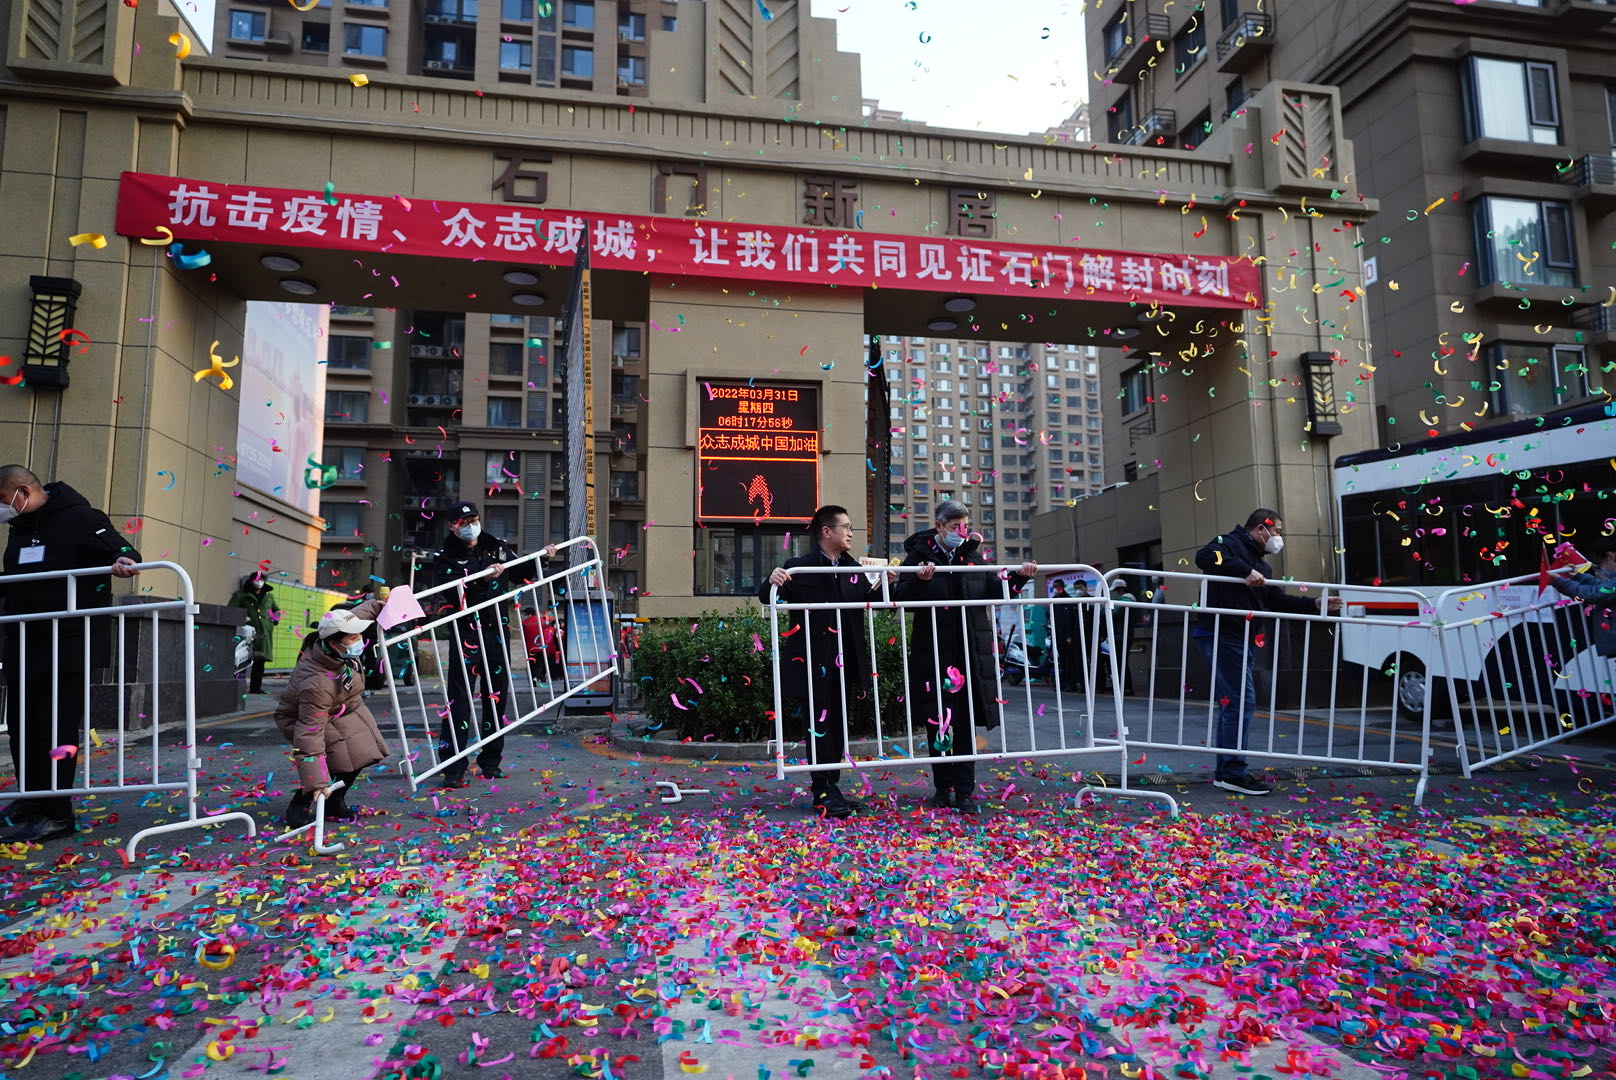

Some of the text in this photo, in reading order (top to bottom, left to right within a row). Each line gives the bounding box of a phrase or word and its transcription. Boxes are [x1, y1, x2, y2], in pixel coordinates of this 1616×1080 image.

[491, 150, 995, 238] 石门新居
[712, 387, 799, 402] 2022年03月31日
[737, 401, 774, 414] 星期四
[700, 433, 818, 453] 众志成城中国加油
